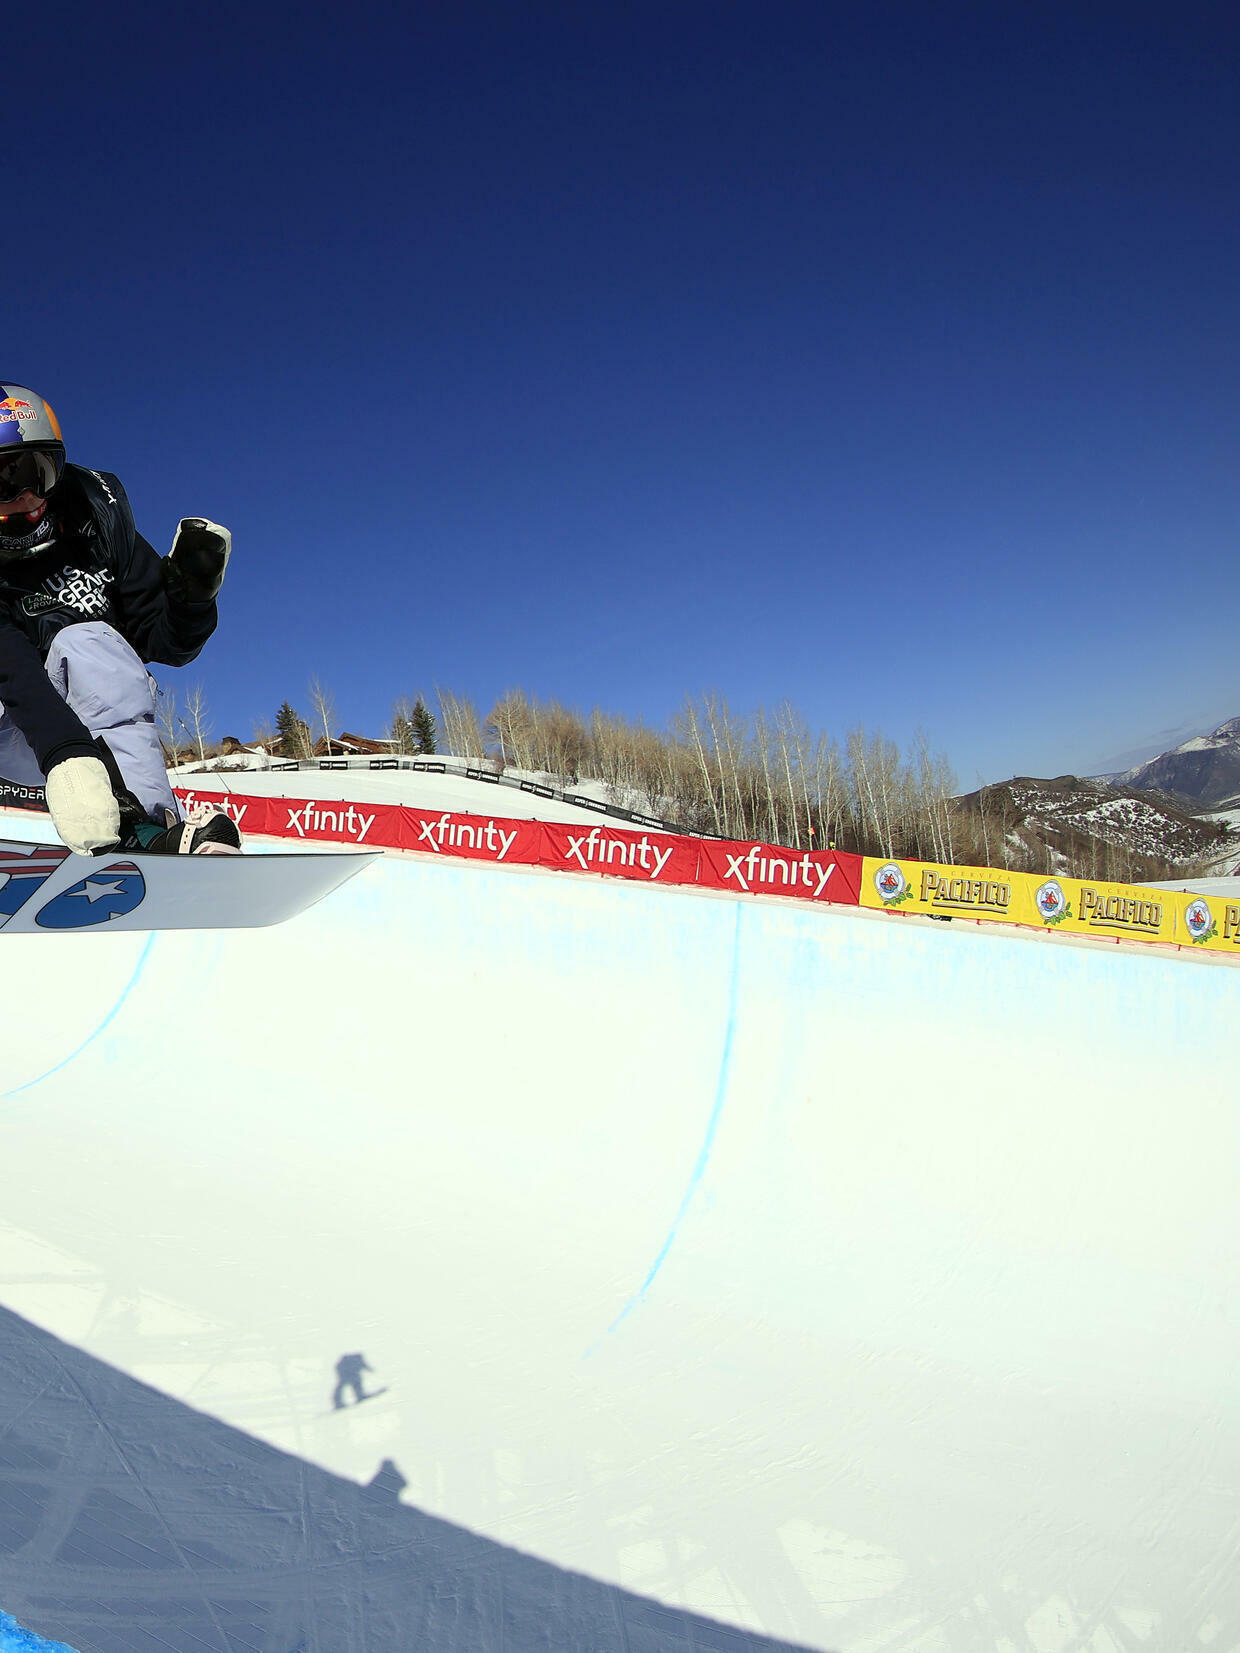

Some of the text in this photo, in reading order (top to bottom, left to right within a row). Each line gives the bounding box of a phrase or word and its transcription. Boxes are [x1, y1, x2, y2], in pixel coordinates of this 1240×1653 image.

[17, 409, 37, 420] Bull
[180, 792, 248, 825] finty
[286, 802, 375, 842] xfinity
[418, 814, 517, 860] xfinity
[565, 828, 674, 878] xfinity
[724, 847, 836, 896] xfinity
[920, 870, 1011, 907] PACIFICO
[950, 871, 1012, 882] CERVEZA
[1078, 888, 1162, 927] PACIFICO
